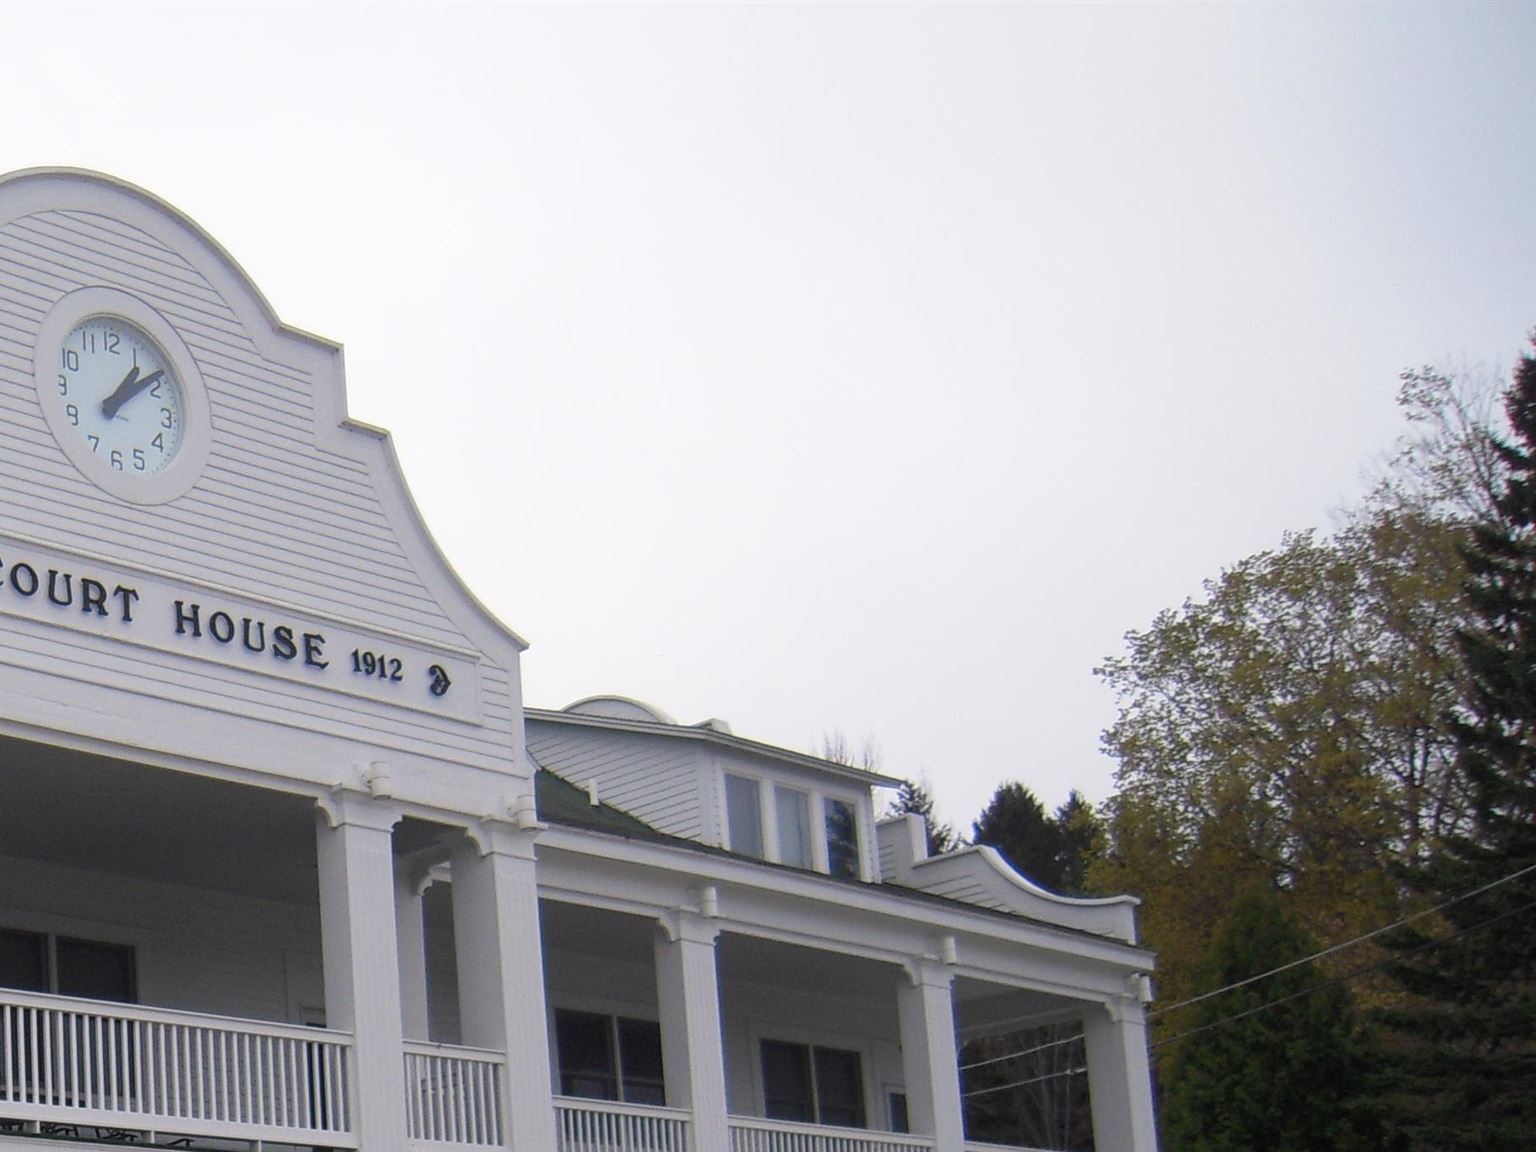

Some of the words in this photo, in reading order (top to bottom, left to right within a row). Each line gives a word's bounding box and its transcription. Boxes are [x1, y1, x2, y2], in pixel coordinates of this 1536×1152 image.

[82, 331, 95, 354] 11
[104, 331, 121, 355] 12
[62, 348, 79, 372] 10
[149, 378, 161, 399] 2
[66, 404, 79, 426] 8
[160, 408, 172, 429] 3
[87, 435, 100, 453] 7
[151, 432, 164, 453] 4
[110, 450, 123, 471] 6
[133, 449, 145, 471] 5
[174, 600, 330, 670] HOUSE
[352, 648, 403, 682] 1912
